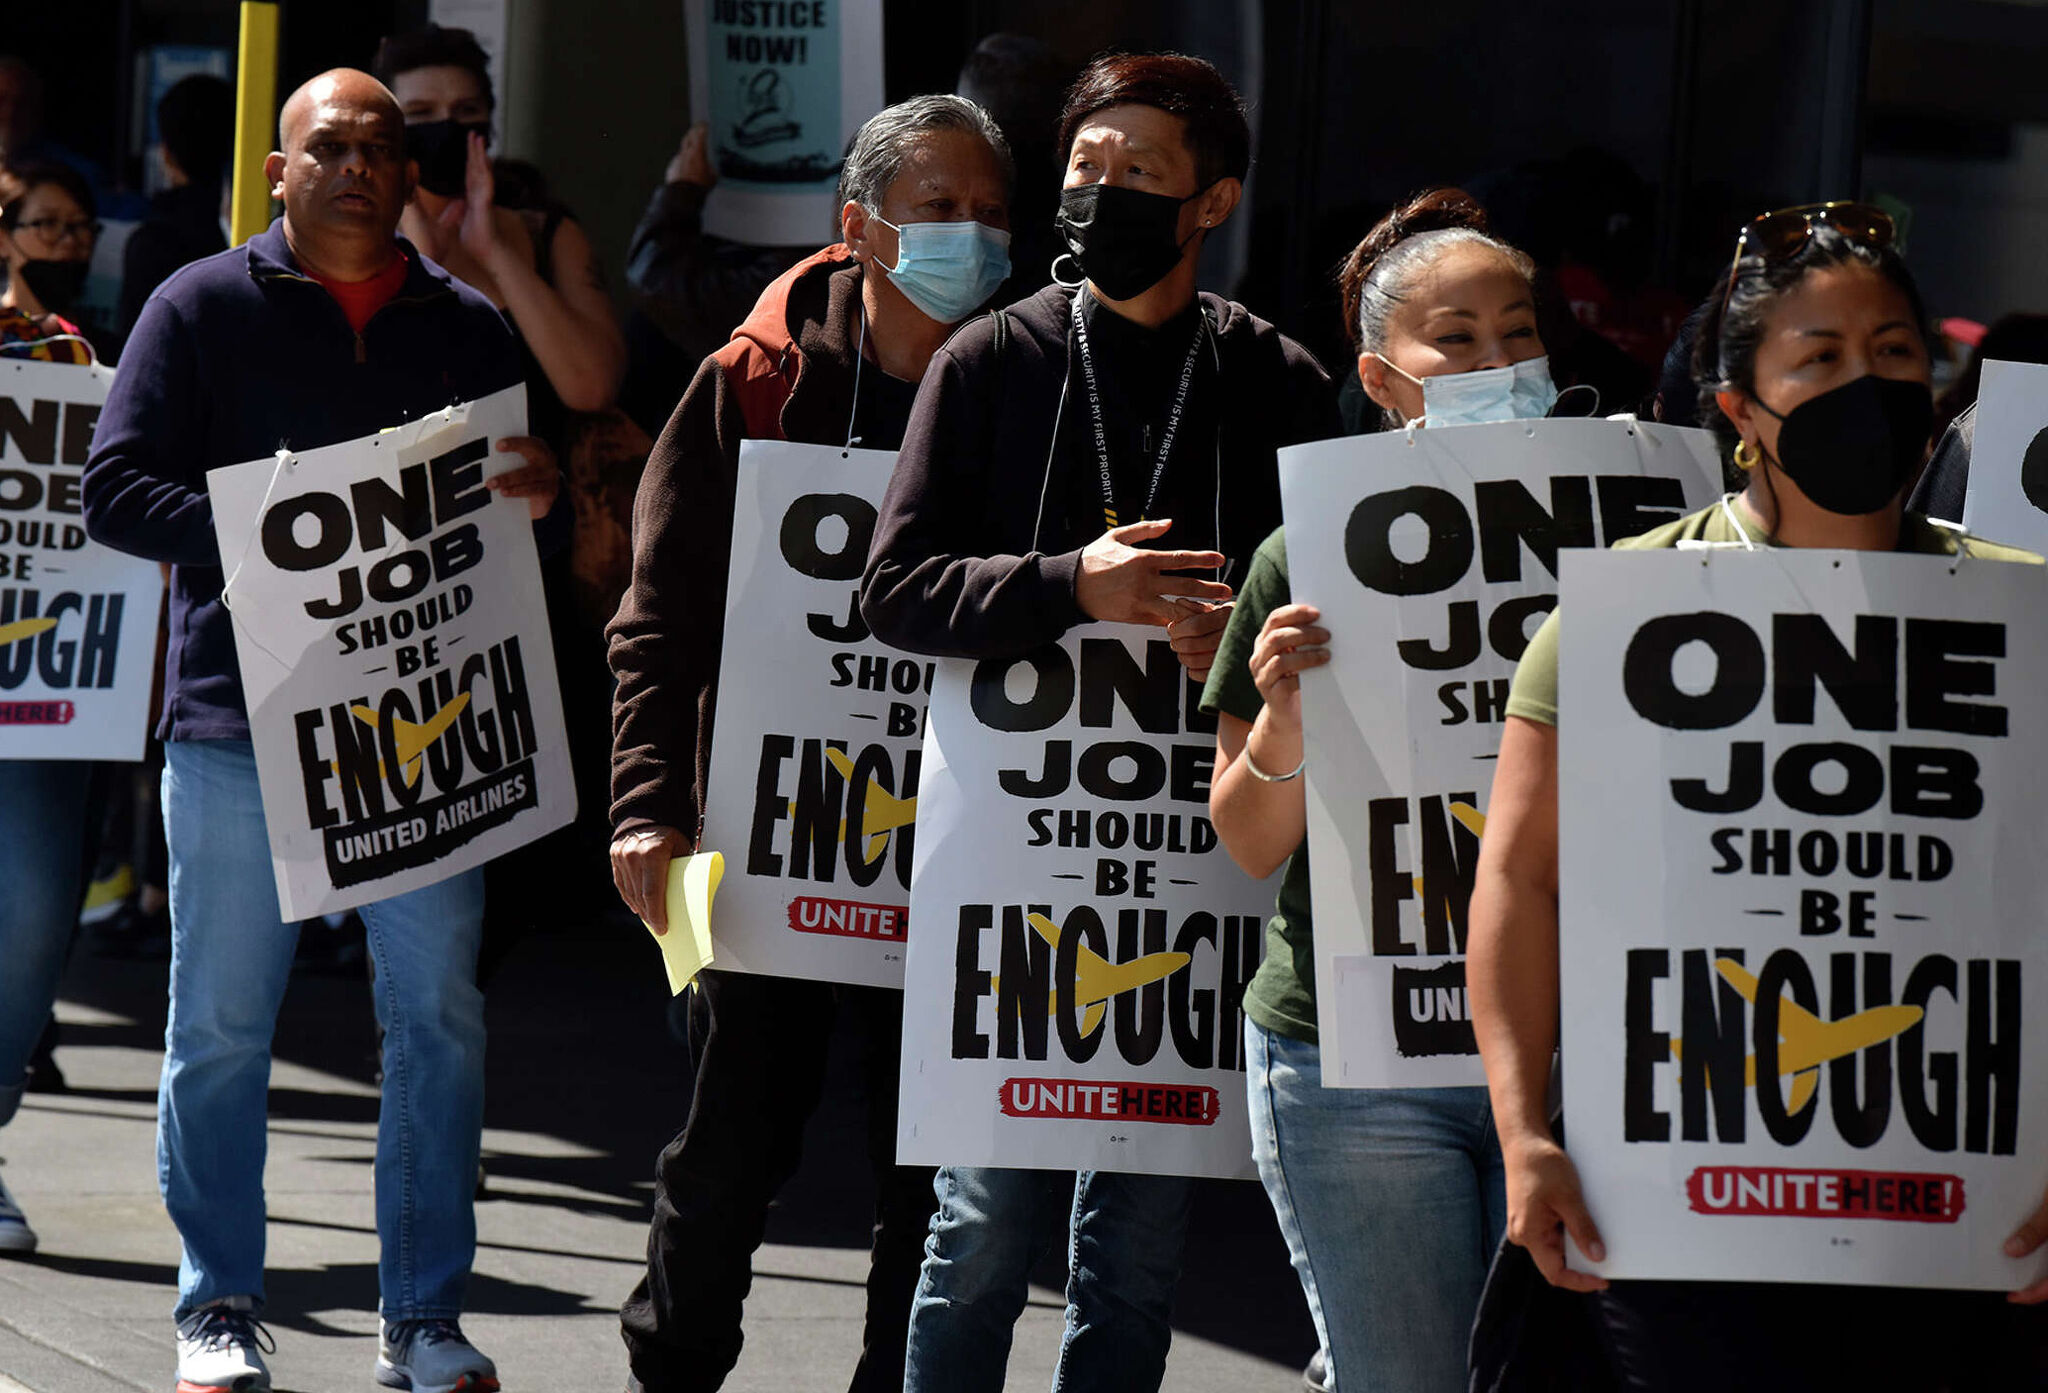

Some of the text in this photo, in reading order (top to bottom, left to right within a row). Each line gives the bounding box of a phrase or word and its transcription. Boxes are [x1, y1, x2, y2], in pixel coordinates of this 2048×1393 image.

[713, 0, 826, 28] JUSTICE
[727, 34, 807, 65] NOW!
[1080, 342, 1097, 392] SECURITY
[1174, 355, 1196, 405] SECURITY
[1090, 393, 1100, 404] IS
[1091, 404, 1102, 421] MY
[1172, 403, 1183, 415] IS
[1094, 422, 1107, 452] FIRST
[1157, 433, 1174, 463] FIRST
[1167, 415, 1180, 434] MY
[1098, 454, 1114, 504] PRIORITY
[261, 437, 491, 571] ONE
[304, 522, 484, 619] JOB
[335, 584, 473, 656] SHOULD
[395, 635, 440, 678] BE
[1624, 612, 2009, 737] ONE
[294, 635, 538, 830] ENOUGH
[887, 702, 928, 740] B
[1671, 741, 1984, 820] JOB
[335, 774, 528, 864] UNITED AIRLINES
[1028, 809, 1218, 854] SHOULD
[1096, 859, 1156, 898] BE
[1711, 828, 1954, 882] SHOULD
[1801, 890, 1876, 938] BE
[952, 904, 1261, 1073] ENOUGH
[1625, 948, 2022, 1156] ENOUGH
